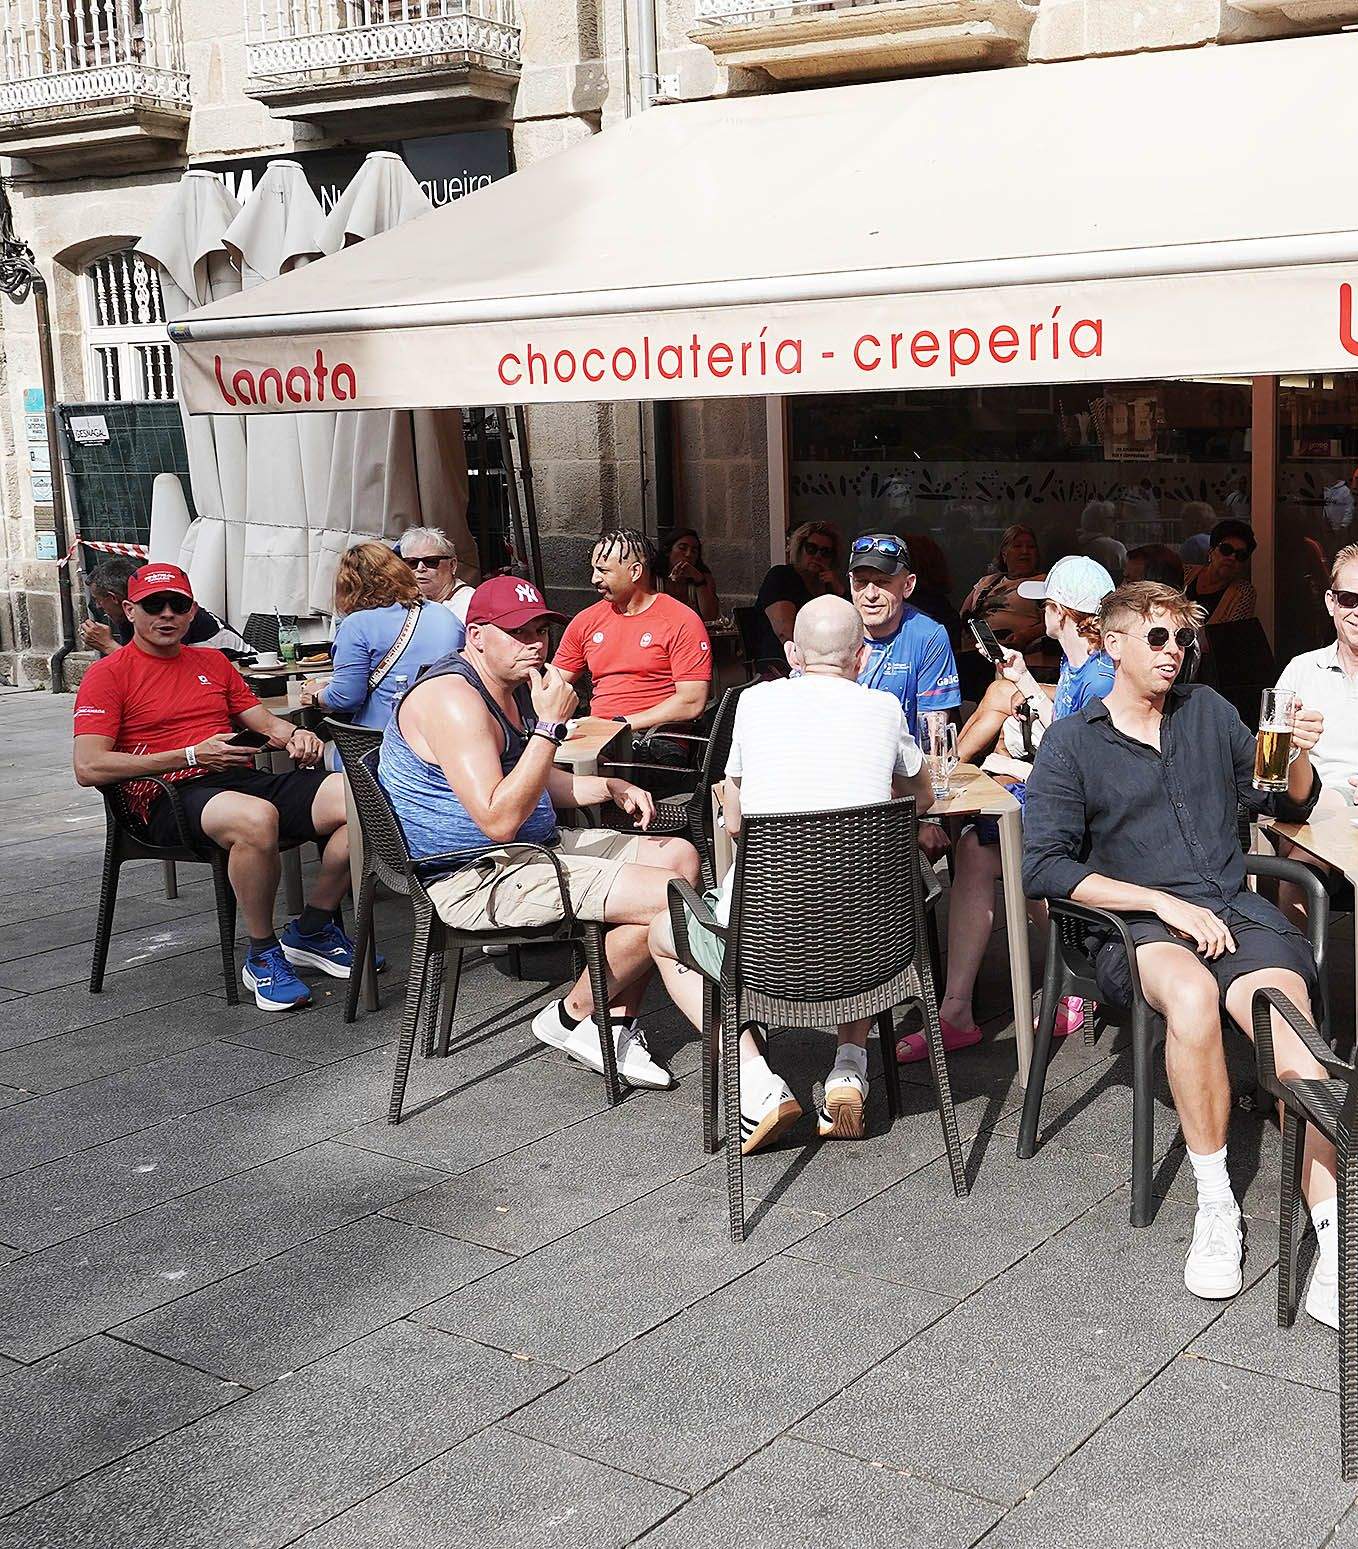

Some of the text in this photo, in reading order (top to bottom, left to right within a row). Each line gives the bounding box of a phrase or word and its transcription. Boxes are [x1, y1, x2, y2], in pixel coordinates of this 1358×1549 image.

[214, 348, 357, 406] Lanata
[498, 326, 803, 386] chocolatería
[853, 305, 1103, 377] crepería
